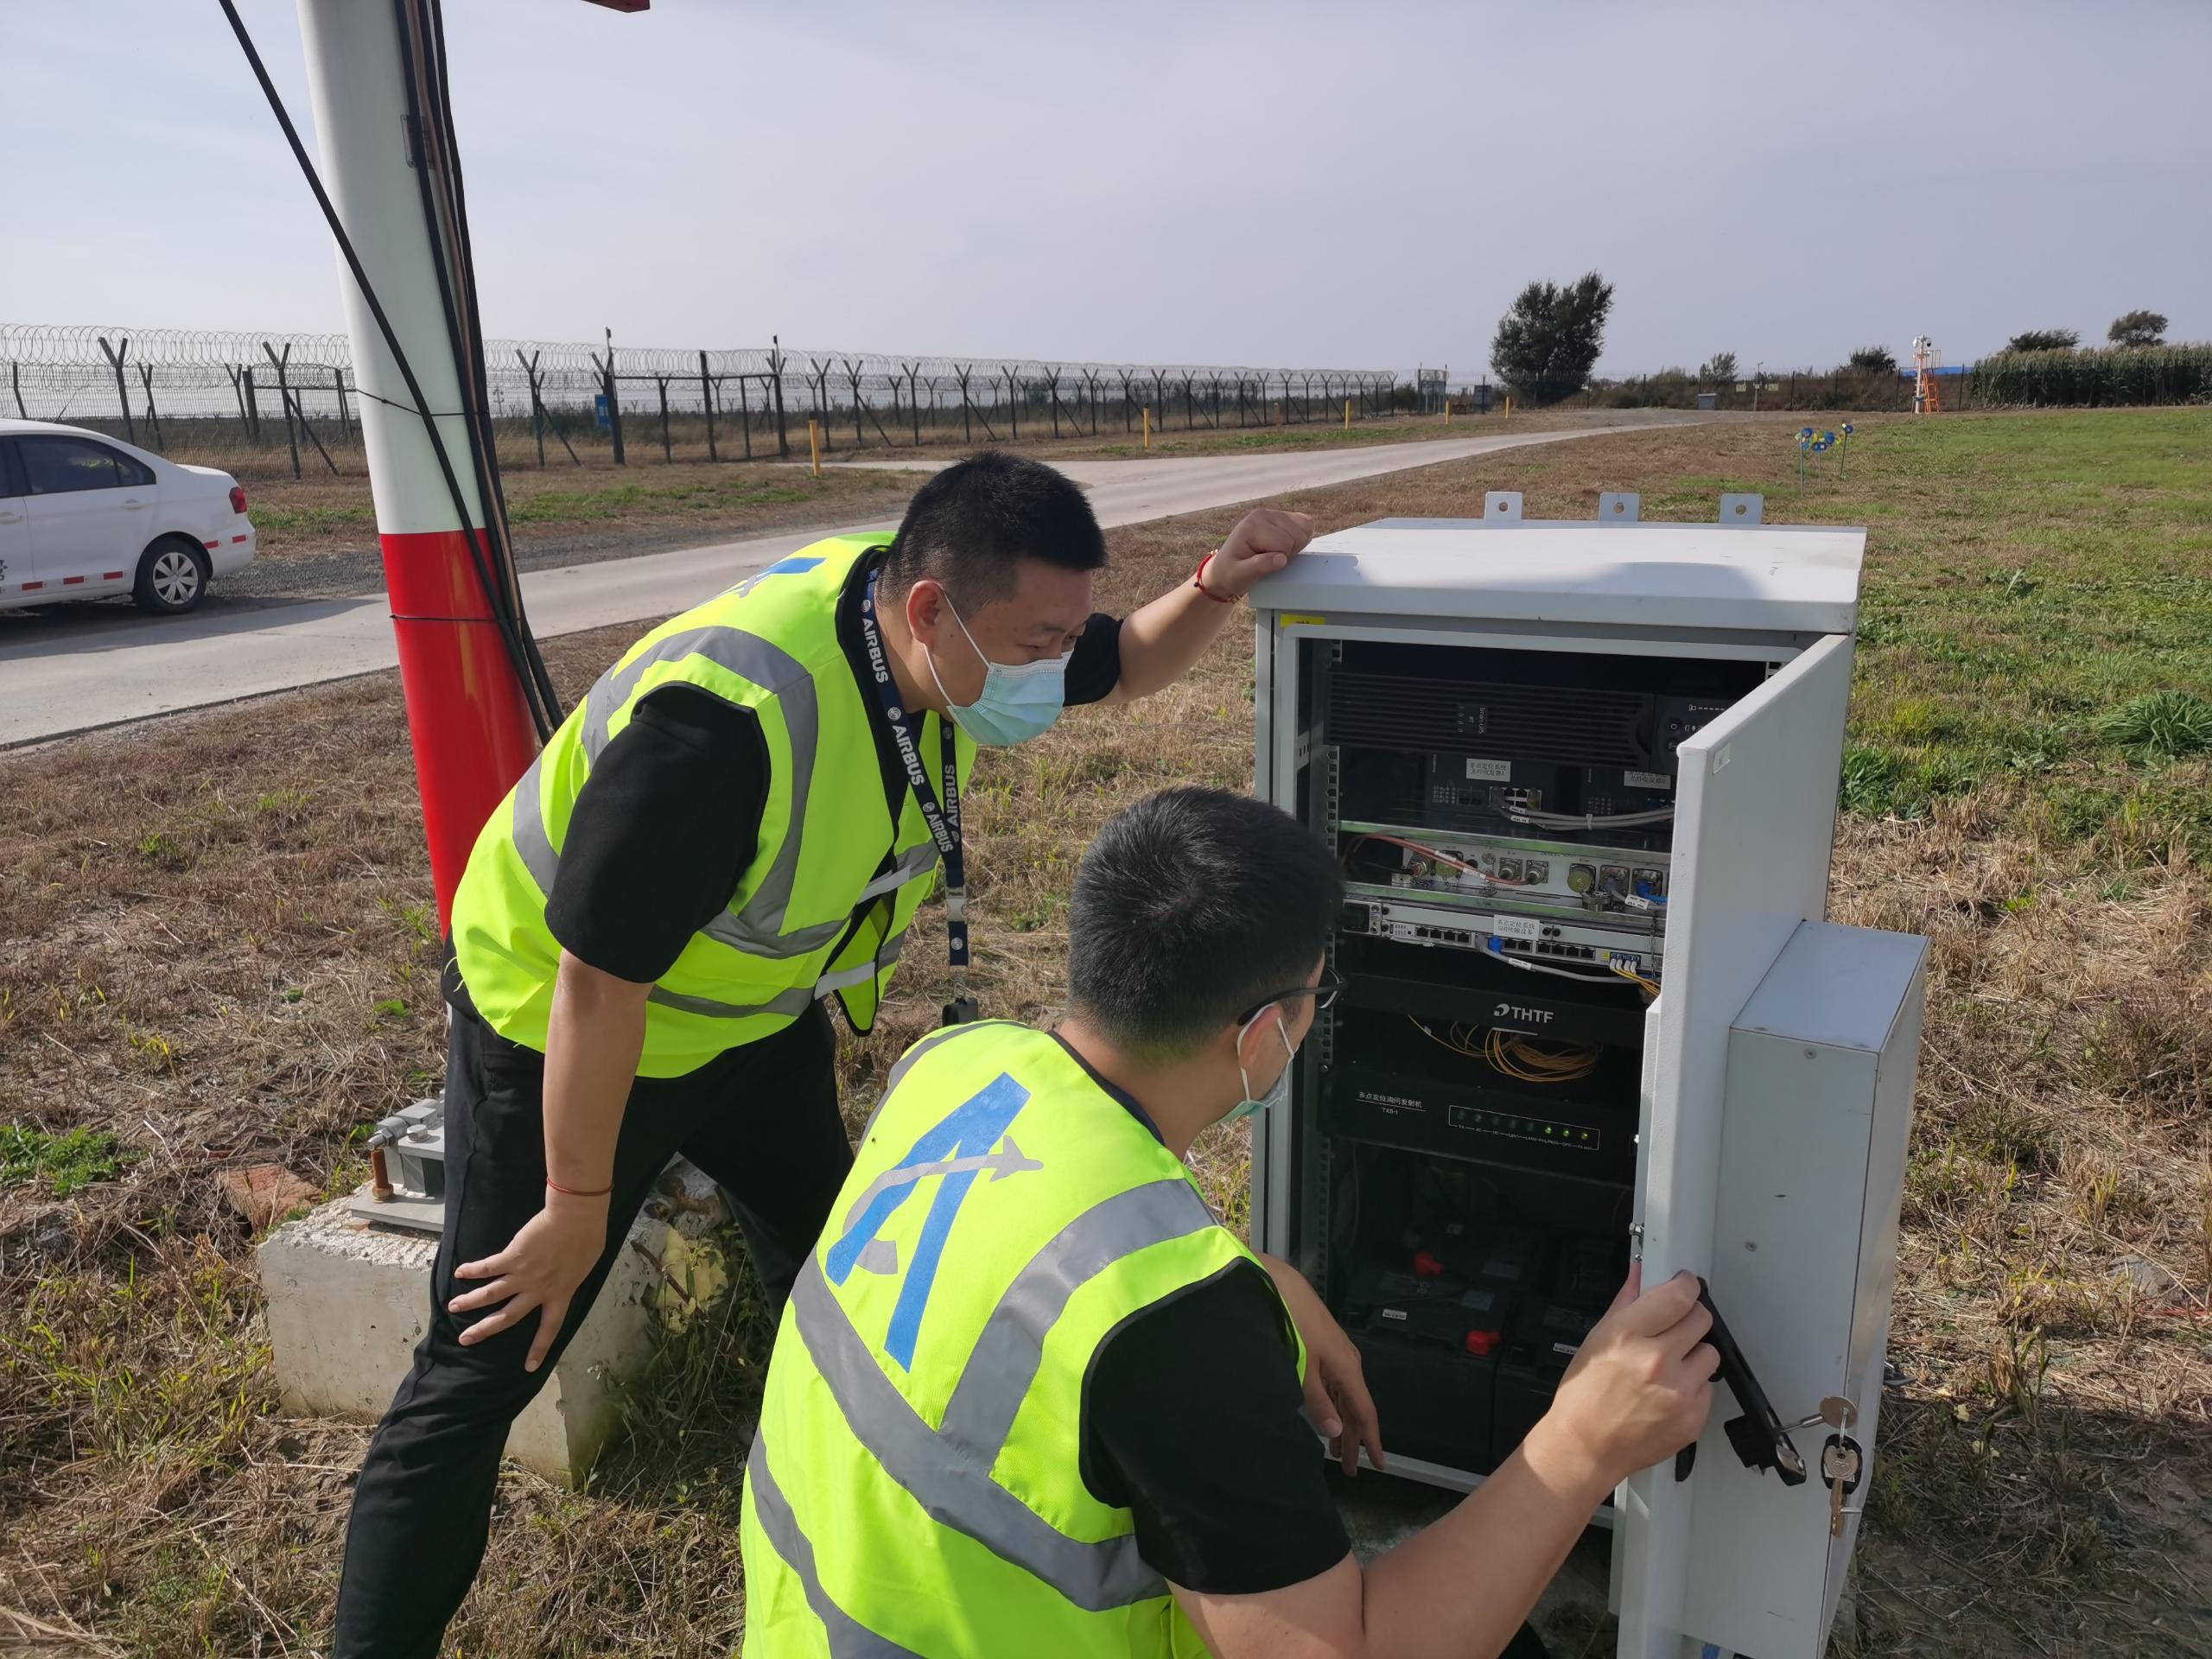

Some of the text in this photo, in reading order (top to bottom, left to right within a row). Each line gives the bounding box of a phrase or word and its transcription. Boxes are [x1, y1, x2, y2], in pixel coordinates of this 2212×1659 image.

[862, 618, 889, 683] AIRBUS
[892, 725, 925, 786] AIRBUS
[944, 764, 958, 828] AIRBUS
[926, 814, 954, 853] AIRBUS
[1510, 1006, 1554, 1024] THTF
